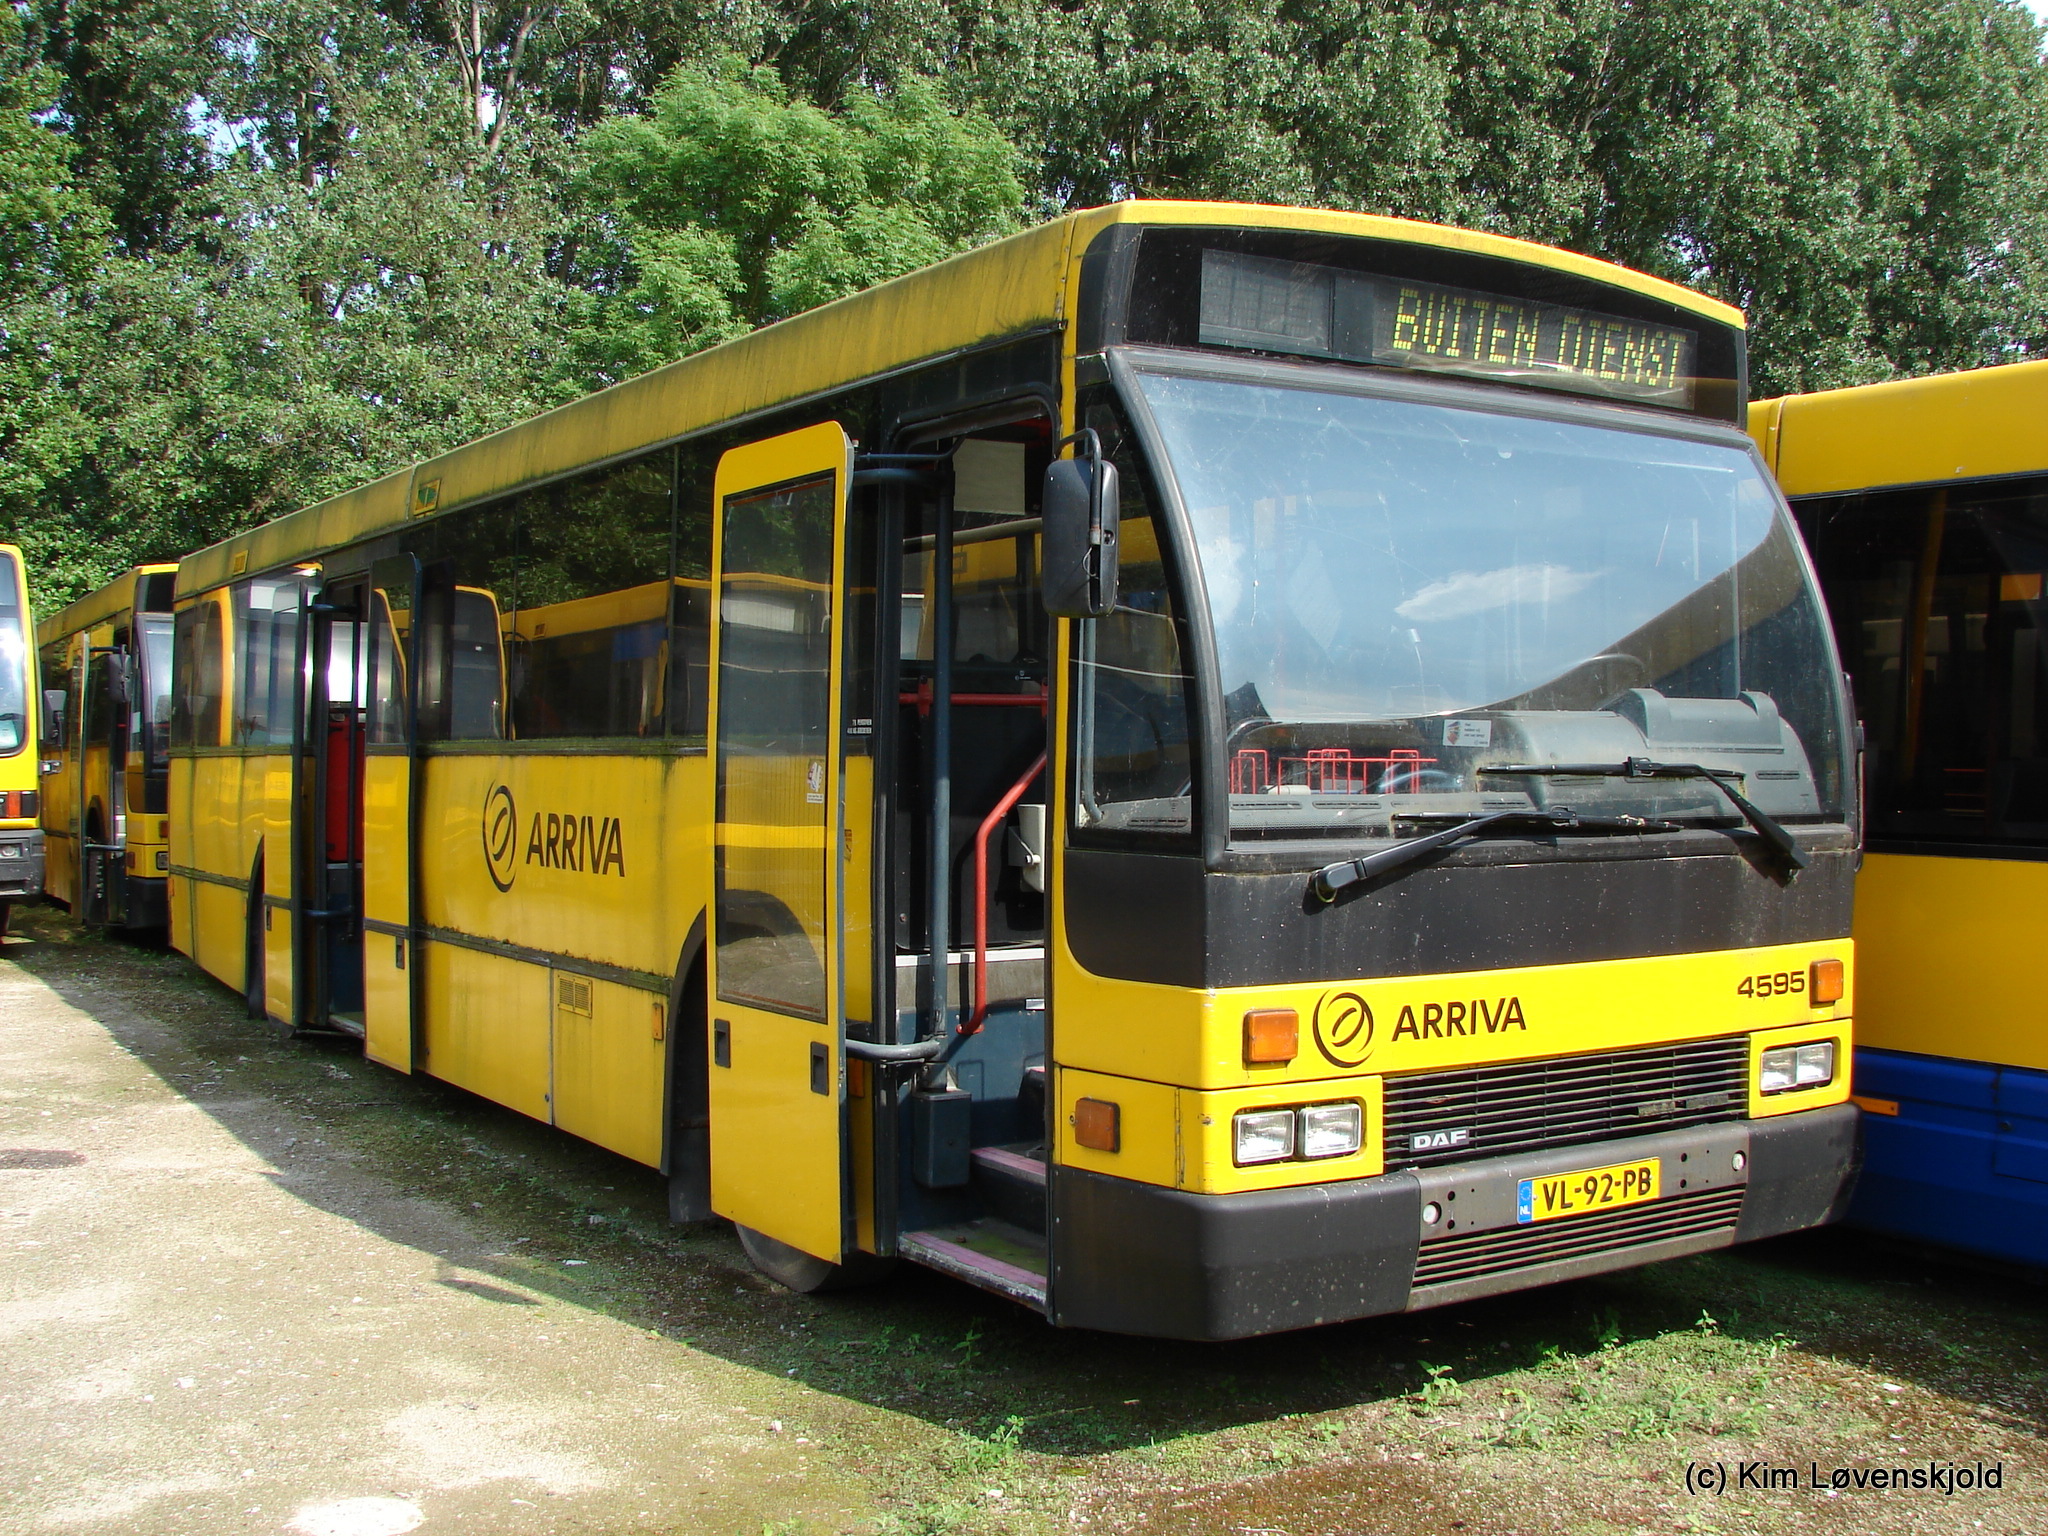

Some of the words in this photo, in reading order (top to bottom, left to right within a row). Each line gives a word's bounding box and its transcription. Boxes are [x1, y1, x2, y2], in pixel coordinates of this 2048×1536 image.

[1393, 288, 1540, 368] BUITEN
[1557, 314, 1687, 389] DIENST
[526, 812, 625, 877] ARRIVA
[1737, 970, 1805, 998] 4595
[1391, 997, 1527, 1042] ARRIVA
[1413, 1130, 1468, 1150] DAF
[1519, 1204, 1531, 1216] NL
[1542, 1166, 1652, 1212] VL-92-PB
